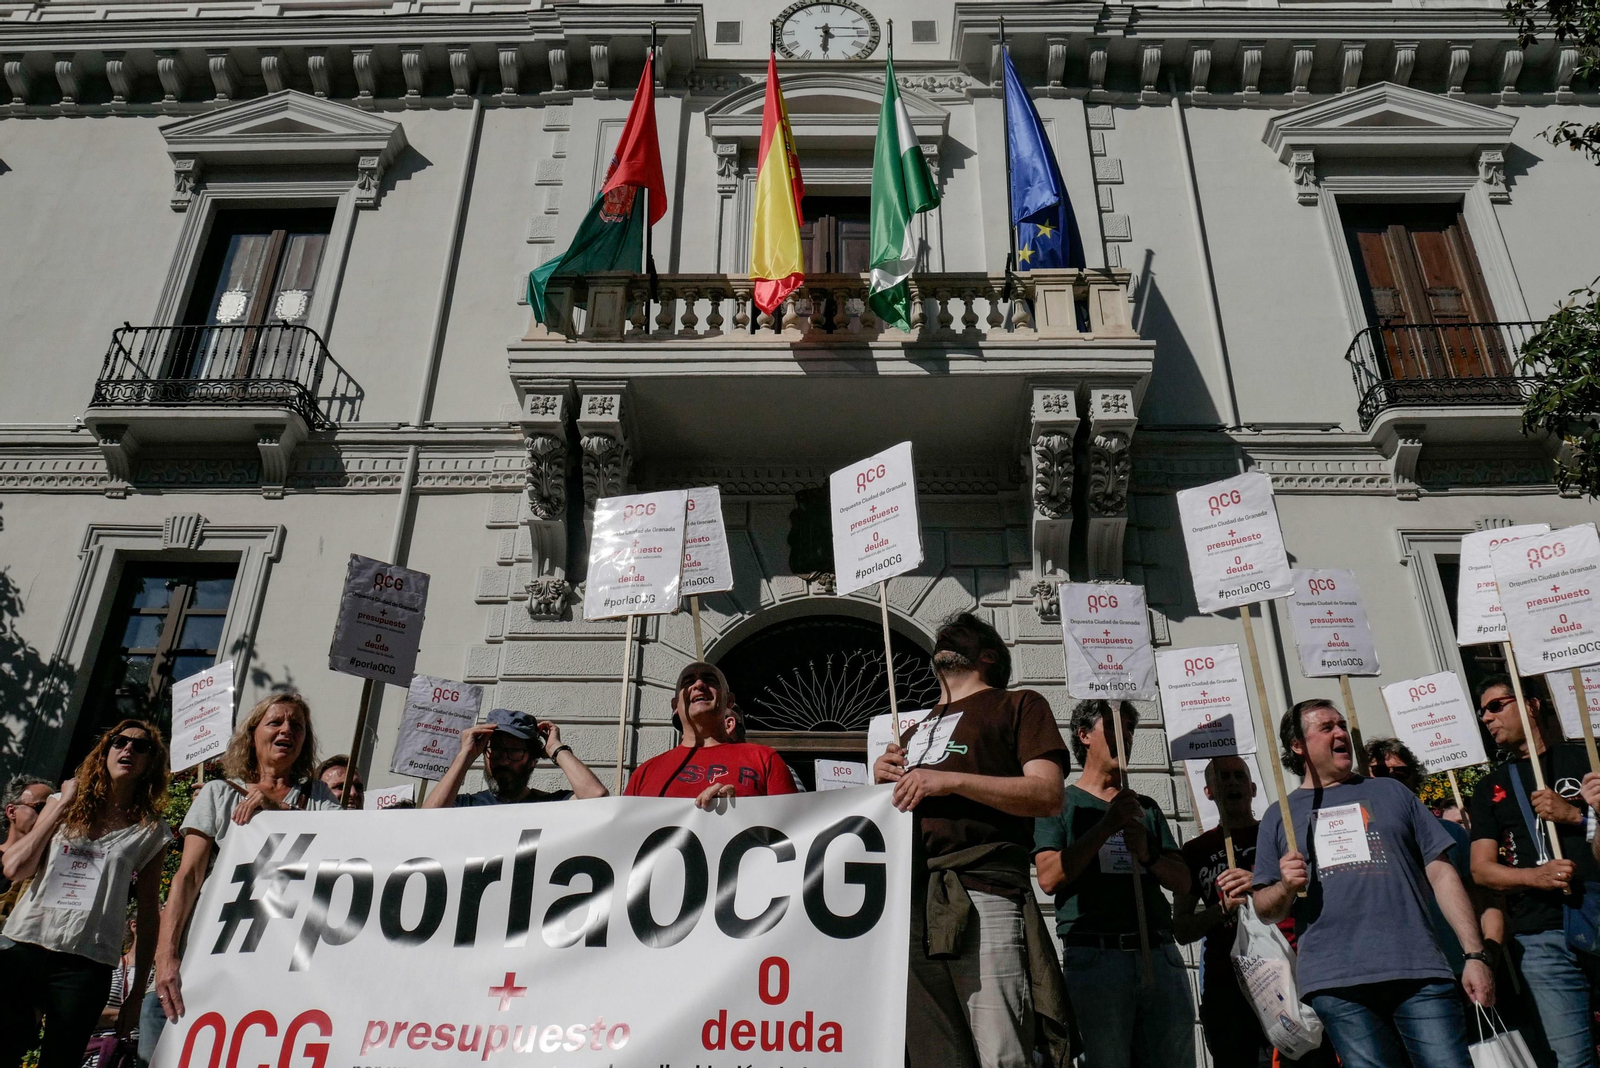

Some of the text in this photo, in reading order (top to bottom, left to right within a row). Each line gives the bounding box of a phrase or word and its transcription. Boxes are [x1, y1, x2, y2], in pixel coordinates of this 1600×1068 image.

[861, 9, 879, 32] QUIEN
[856, 464, 886, 494] OCG
[1208, 490, 1241, 516] OCG
[850, 505, 899, 531] presupuesto
[873, 532, 879, 541] 0
[1206, 533, 1262, 552] presupuesto
[864, 538, 889, 553] deuda
[683, 560, 702, 568] euda
[1234, 556, 1241, 565] 0
[1527, 542, 1566, 570] OCG
[855, 554, 902, 579] #porlaOCG
[1226, 563, 1254, 574] deuda
[374, 573, 403, 591] OCG
[618, 574, 645, 583] deuda
[1509, 577, 1537, 588] Orquesta
[1538, 572, 1560, 582] Ciudad
[1570, 564, 1597, 575] Granada
[1218, 580, 1271, 599] #porlaOCG
[1309, 579, 1336, 596] OCG
[1088, 595, 1118, 614] OCG
[1526, 588, 1590, 609] presupuesto
[358, 612, 406, 629] presupuesto
[1310, 617, 1353, 625] presupuesto
[1560, 613, 1567, 624] 0
[1477, 624, 1506, 634] #porla
[1550, 622, 1582, 635] deuda
[365, 641, 389, 651] deuda
[376, 634, 381, 642] 0
[1542, 640, 1600, 661] #porlaOCG
[350, 657, 395, 675] #porlaOCG
[1184, 657, 1215, 677] OCG
[1322, 658, 1363, 668] #porlaOCG
[192, 676, 213, 698] OCG
[432, 688, 459, 703] OCG
[1089, 682, 1137, 692] #porlaOCG
[1409, 683, 1436, 702] OCG
[1181, 696, 1230, 707] presupuesto
[184, 706, 220, 725] presupuesto
[1411, 715, 1456, 730] presupuesto
[417, 722, 460, 734] presupuesto
[1198, 721, 1222, 730] deuda
[193, 730, 211, 741] deuda
[1189, 738, 1236, 750] #porlaOCG
[1430, 738, 1452, 747] deuda
[1435, 732, 1442, 740] 0
[186, 740, 219, 760] #porlaOCG
[423, 746, 444, 754] deuda
[1425, 751, 1467, 767] #porlaOCG
[1210, 845, 1243, 862] REL
[210, 815, 886, 972] #porlaOCG
[759, 957, 790, 1006] 0
[488, 972, 527, 1011] +
[701, 1010, 843, 1053] deuda
[359, 1020, 630, 1061] presupuesto
